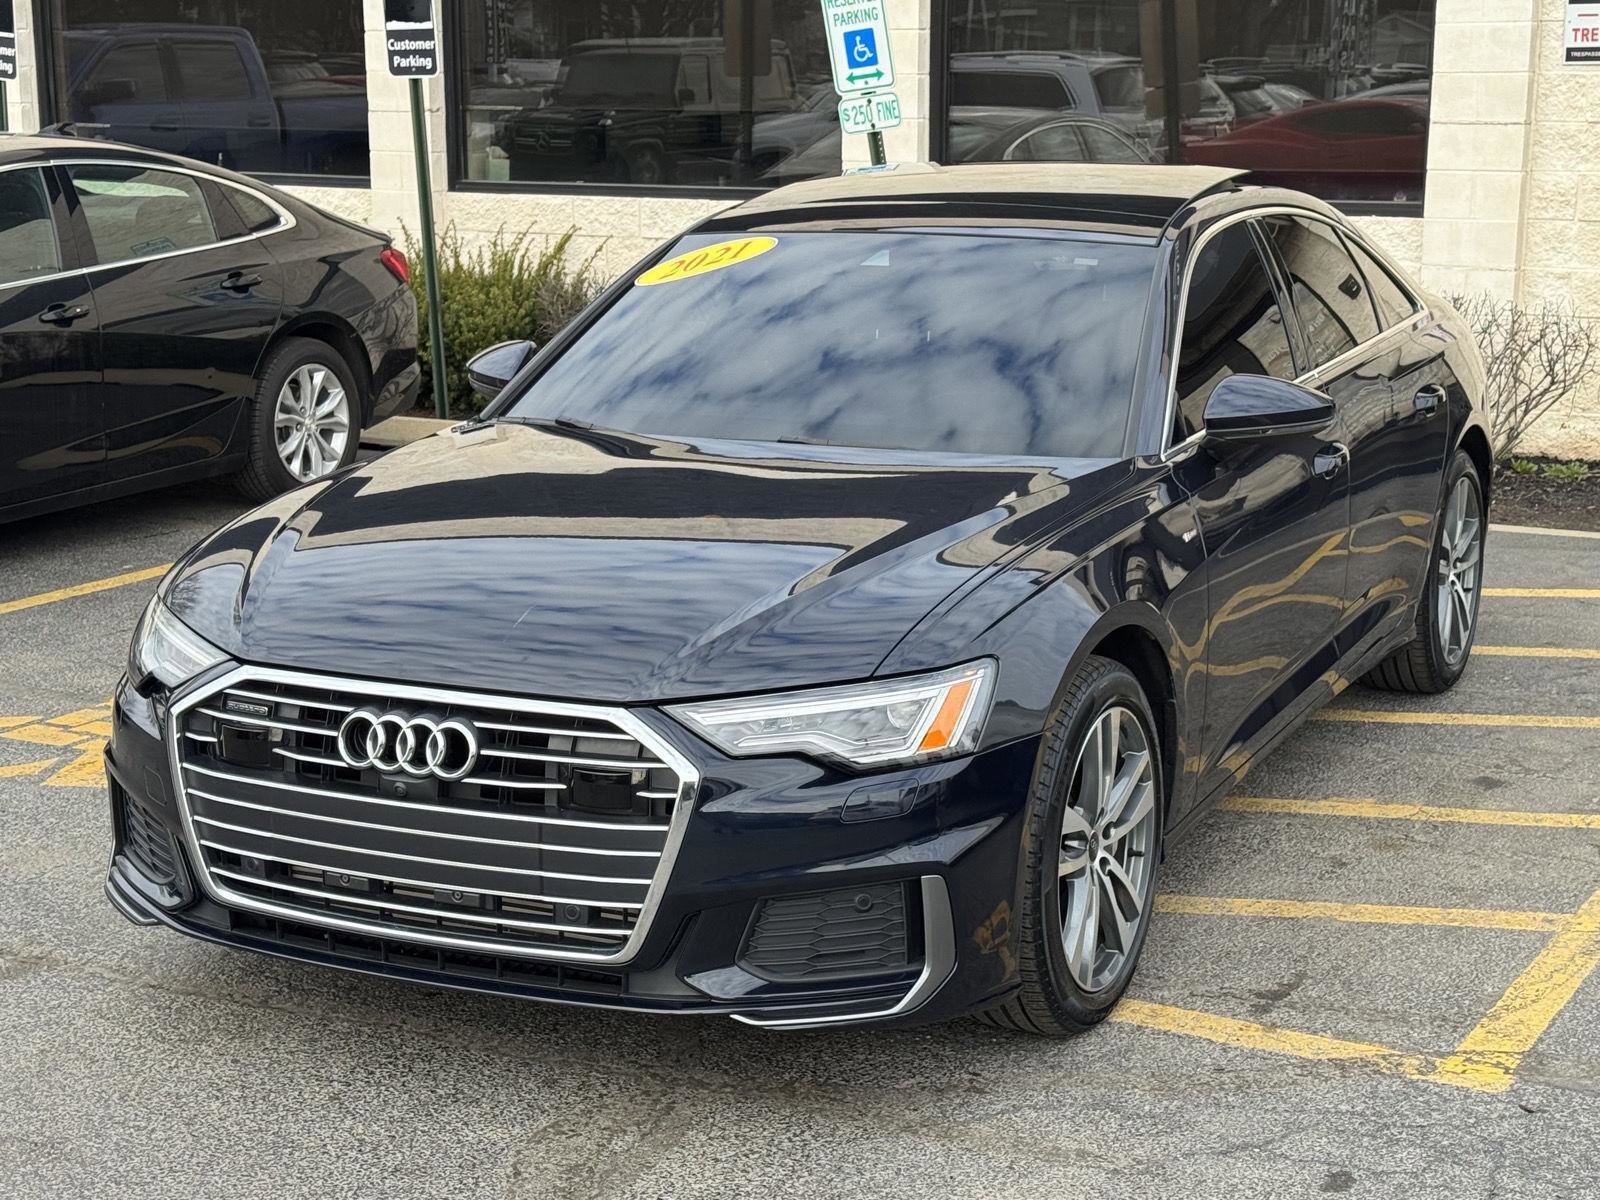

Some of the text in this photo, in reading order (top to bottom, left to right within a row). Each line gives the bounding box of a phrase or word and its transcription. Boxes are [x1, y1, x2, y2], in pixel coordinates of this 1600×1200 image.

[833, 7, 879, 27] PARKING
[387, 39, 435, 51] Customer
[393, 55, 432, 69] Parking
[876, 100, 900, 121] FINE
[659, 241, 752, 280] 2021
